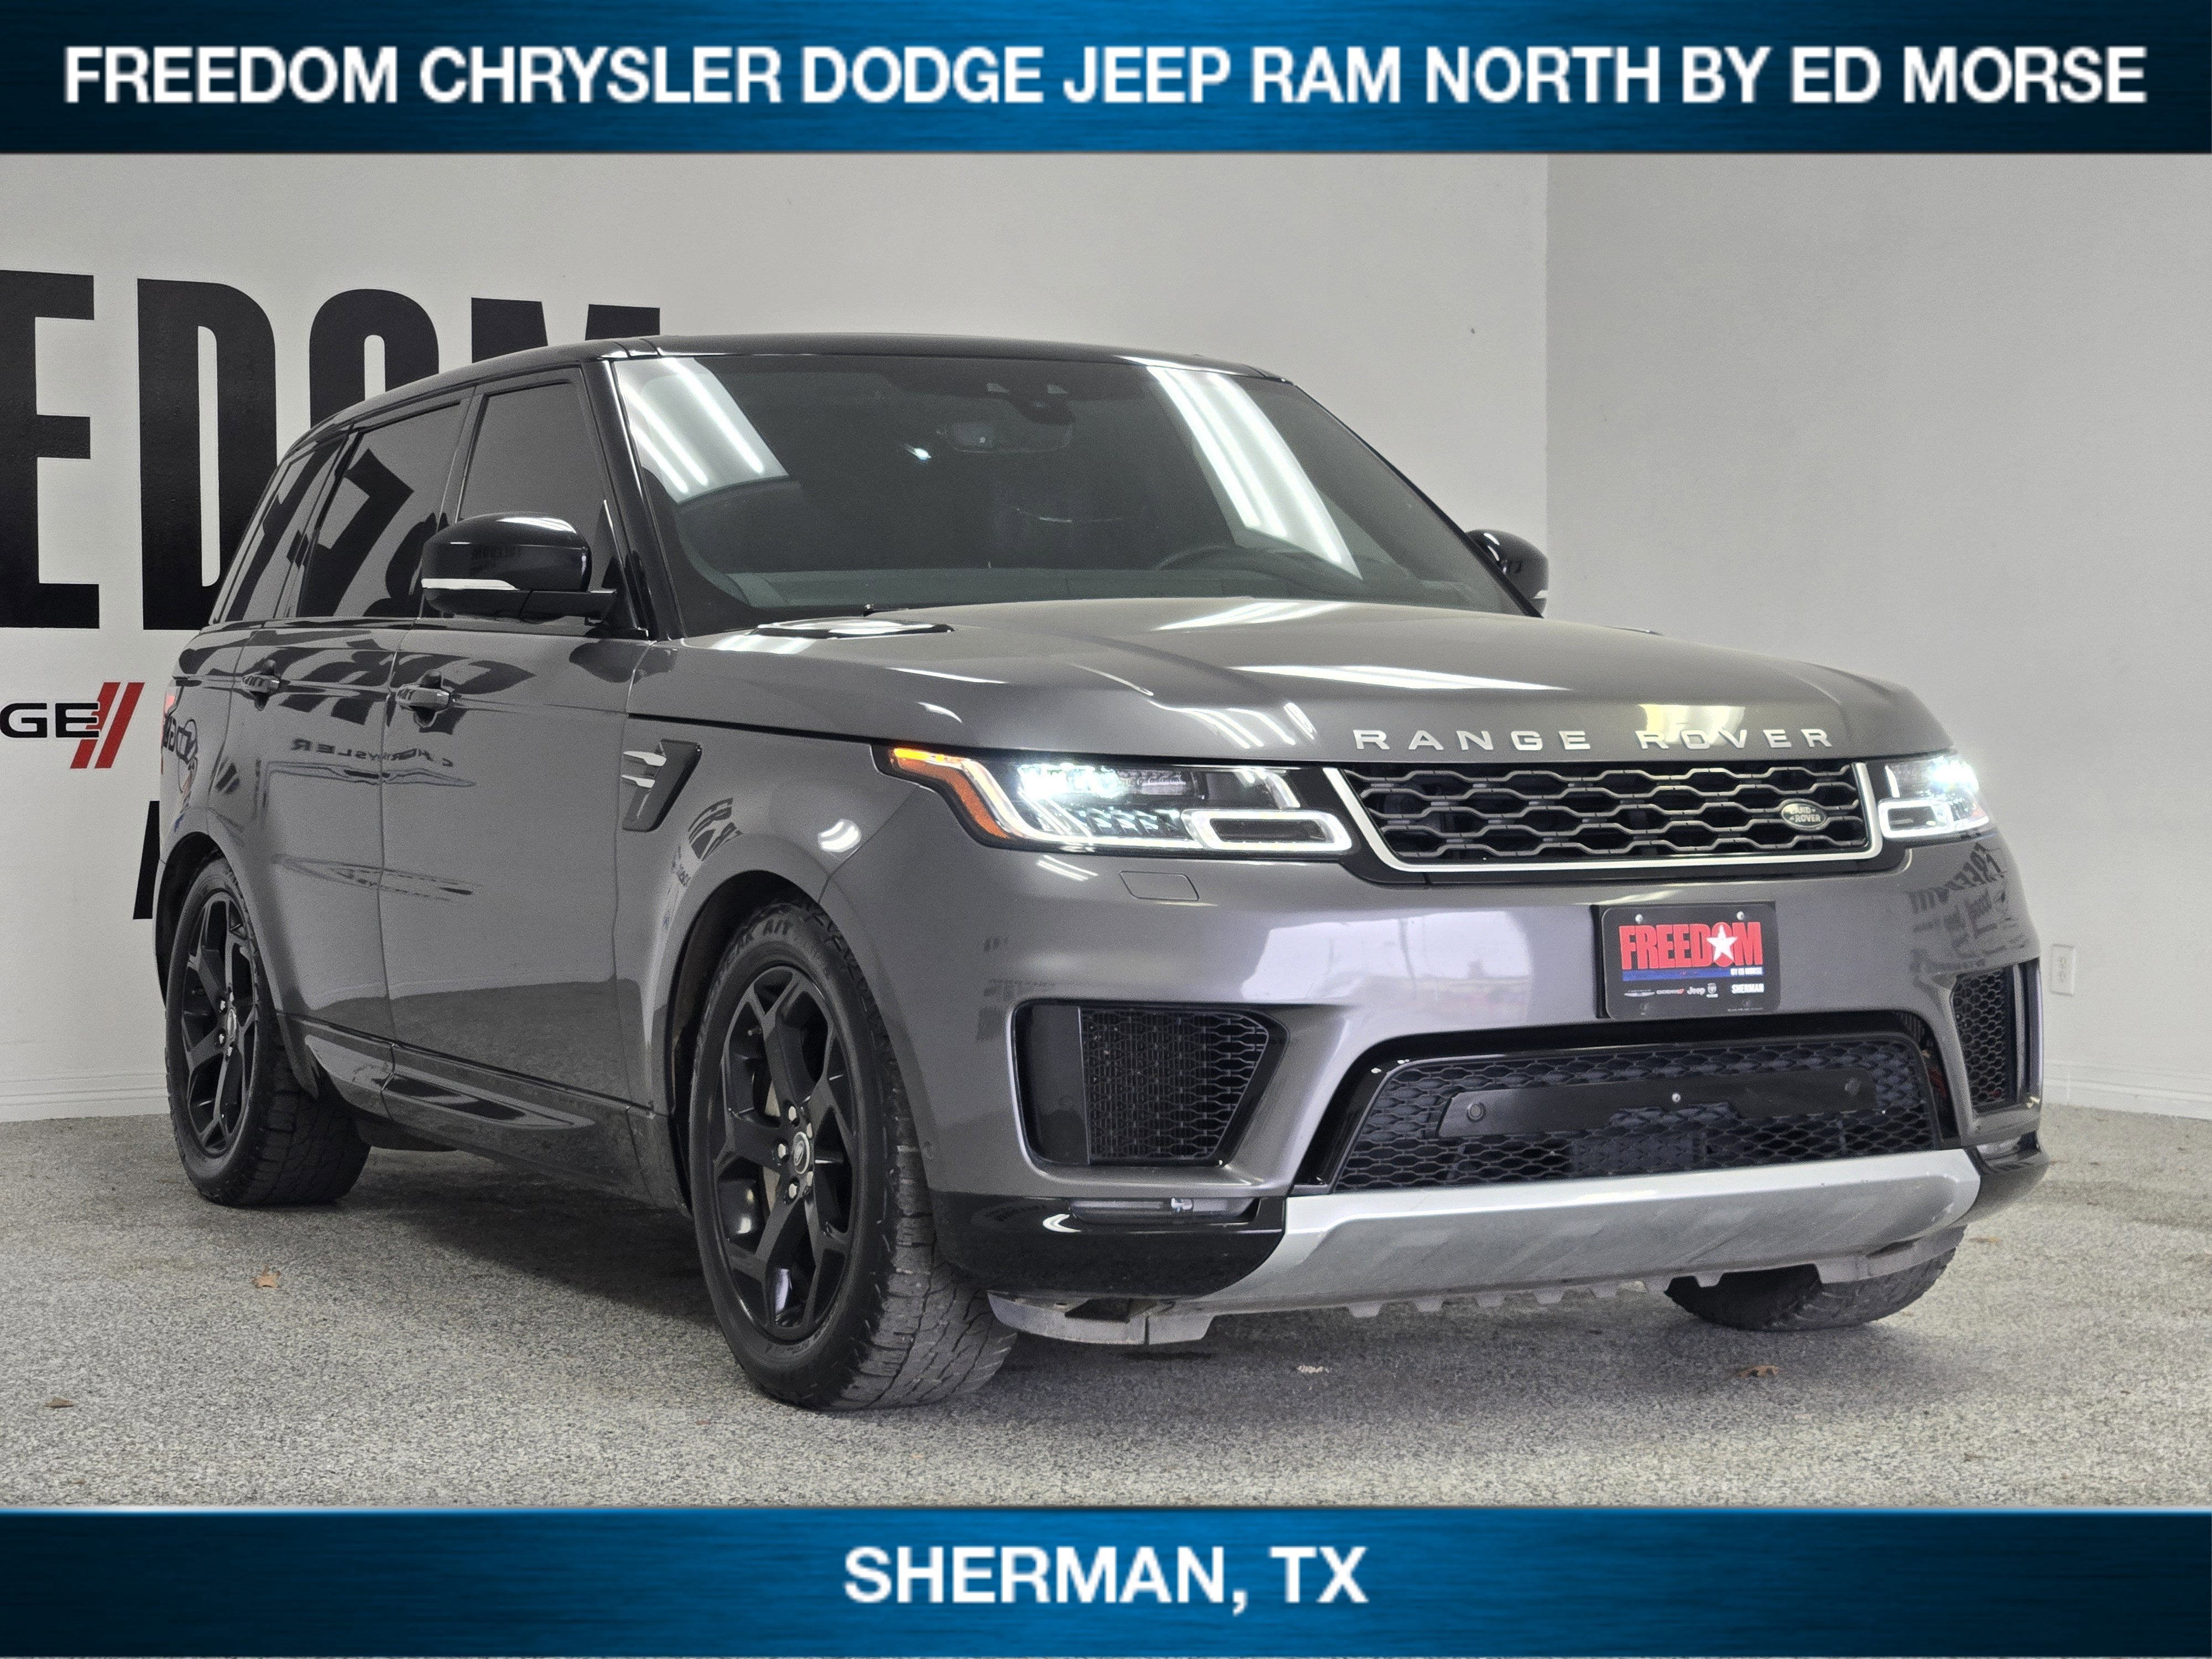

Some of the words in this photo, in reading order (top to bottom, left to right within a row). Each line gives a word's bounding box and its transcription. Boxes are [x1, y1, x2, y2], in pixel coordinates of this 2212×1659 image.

[0, 270, 660, 631] ED
[1353, 728, 1592, 752] RANGE
[1635, 727, 1833, 750] ROVER
[1794, 814, 1822, 823] ROVER
[1619, 921, 1764, 970] FREEDOM
[1686, 986, 1706, 995] Jeep
[1731, 983, 1765, 994] SHERMAN
